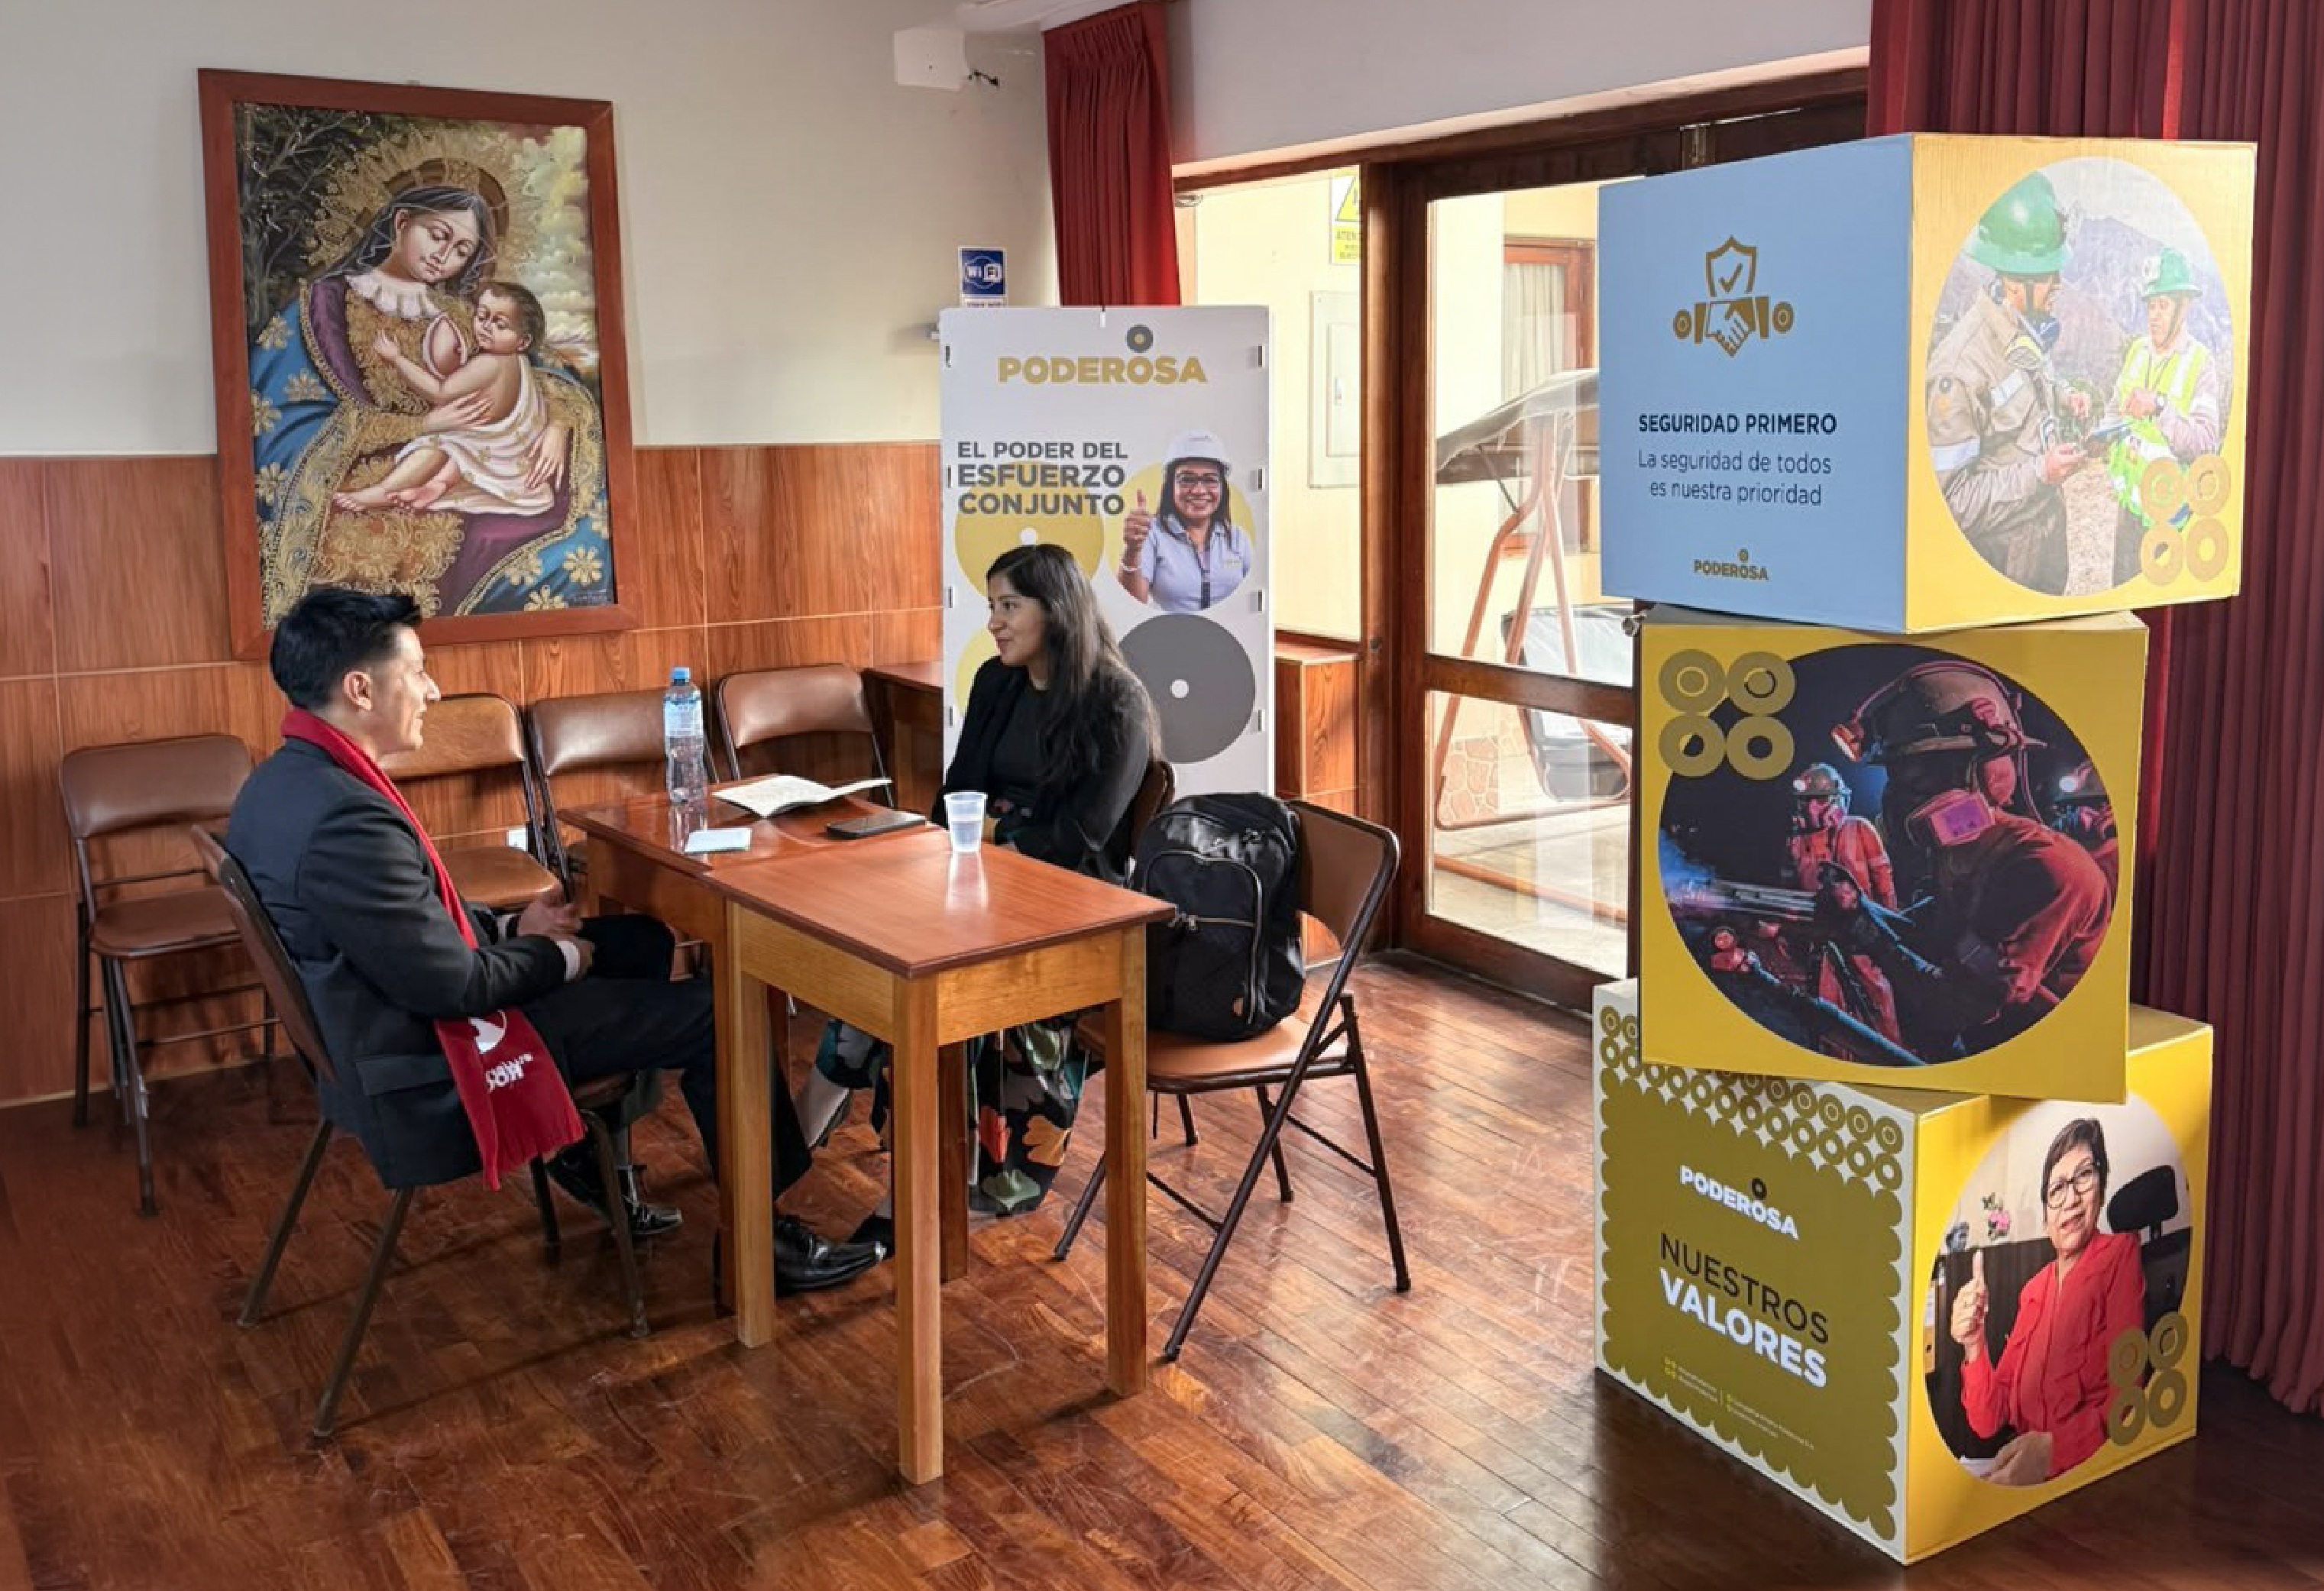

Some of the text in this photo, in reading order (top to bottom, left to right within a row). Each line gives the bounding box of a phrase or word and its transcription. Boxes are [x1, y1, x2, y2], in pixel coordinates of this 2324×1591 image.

[998, 356, 1208, 385] PODEROSA
[1638, 412, 1837, 435] SEGURIDAD PRIMERO
[958, 441, 1128, 458] EL PODER DEL
[1638, 450, 1831, 474] La seguridad de todos
[958, 464, 1125, 487] ESFUERZO
[957, 493, 1125, 515] CONJUNTO
[1649, 481, 1821, 506] es nuestra prioridad
[1693, 560, 1769, 580] PODEROSA
[1679, 1165, 1799, 1240] PODEROSA
[1659, 1233, 1829, 1344] NUESTROS
[1659, 1266, 1827, 1388] VALORES
